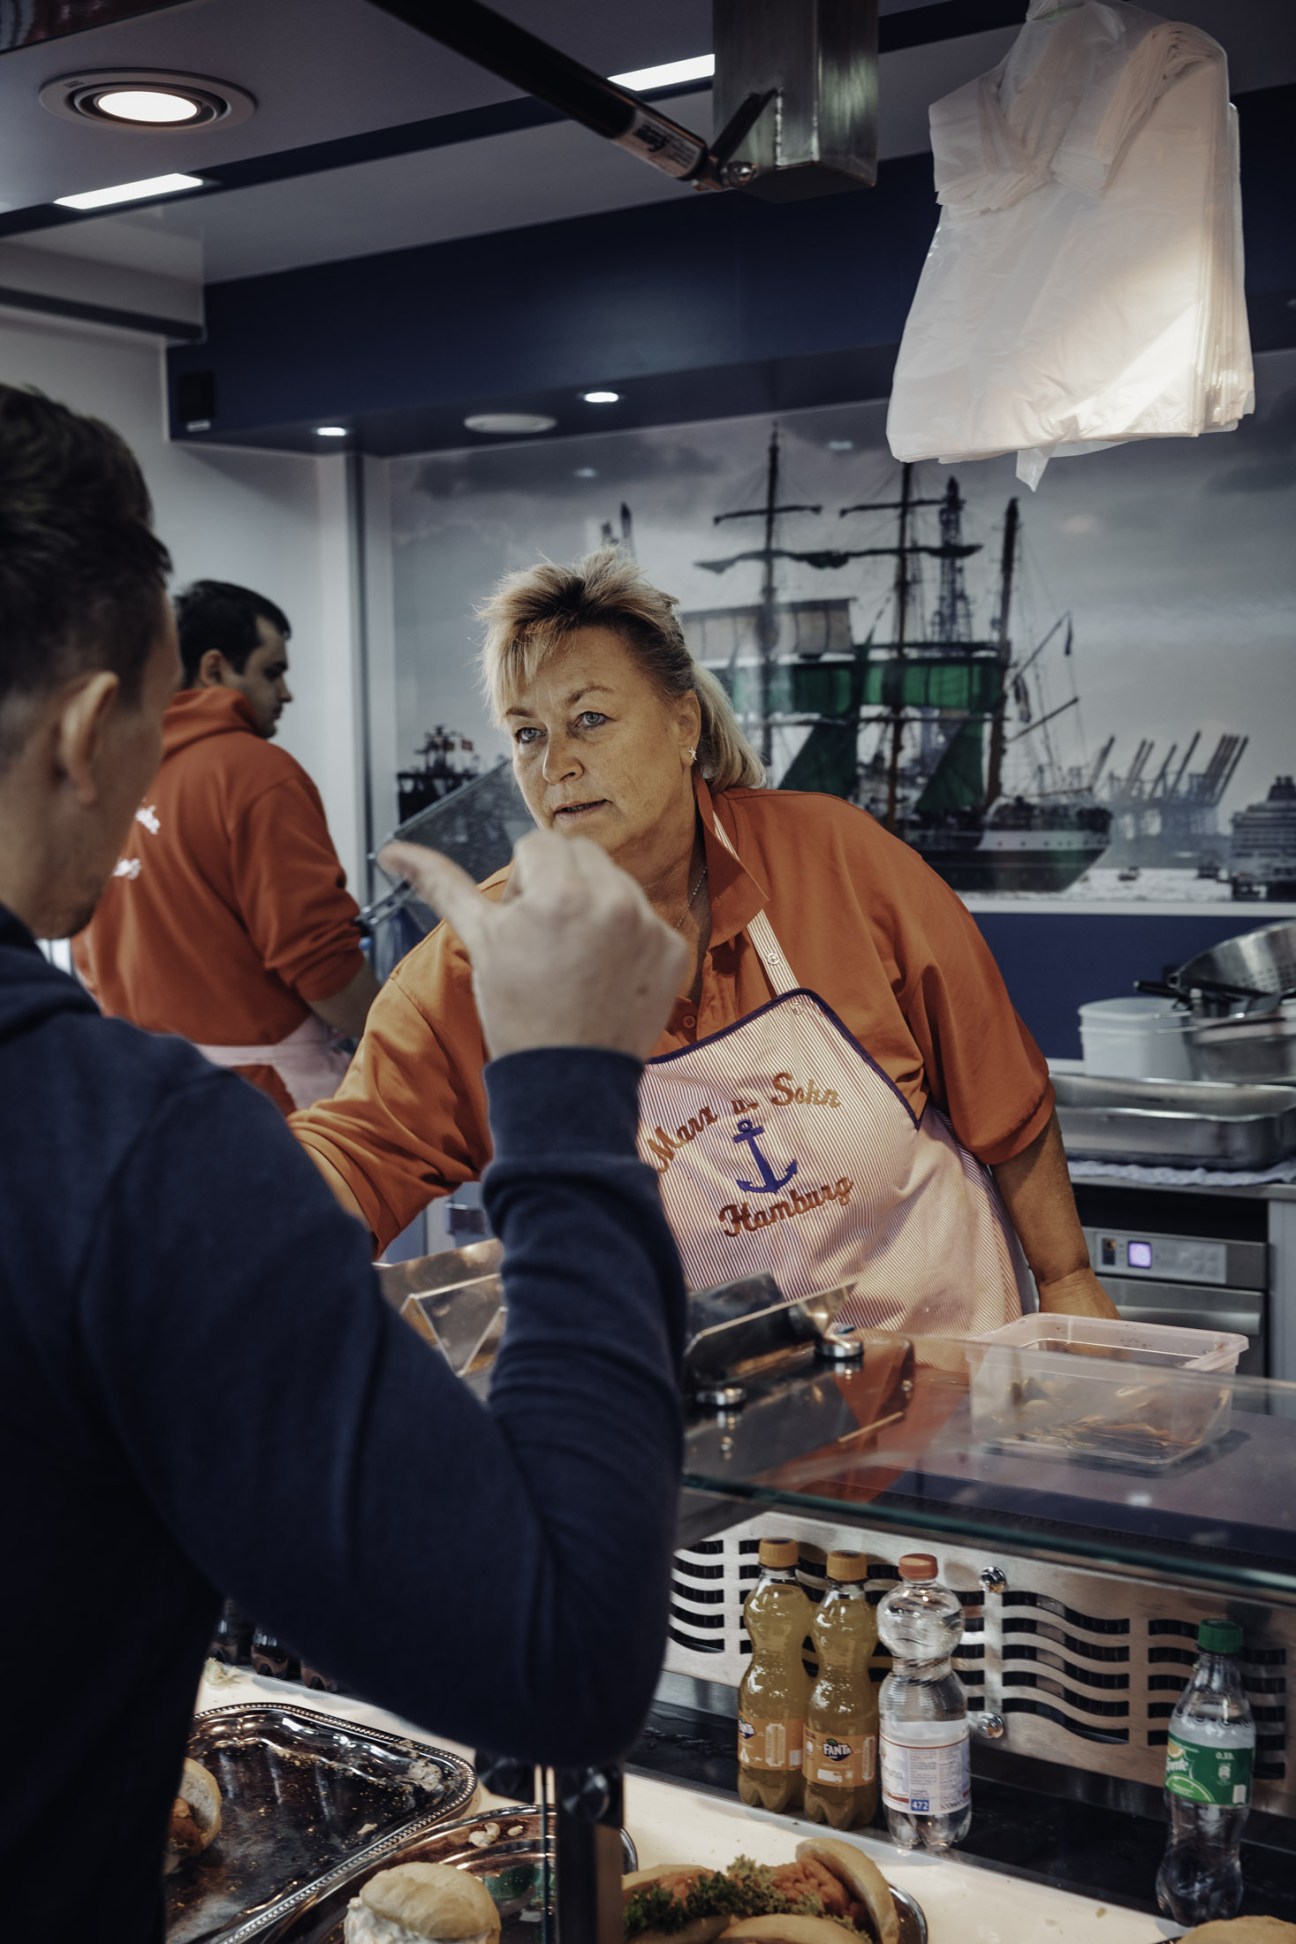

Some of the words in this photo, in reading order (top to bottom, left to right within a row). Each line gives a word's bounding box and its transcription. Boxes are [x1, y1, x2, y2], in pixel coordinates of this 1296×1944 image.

[647, 1105, 718, 1173] Marx
[769, 1071, 841, 1108] Sohn
[719, 1176, 854, 1238] Hamburg
[822, 1743, 853, 1758] FANTA
[911, 1800, 930, 1811] 472
